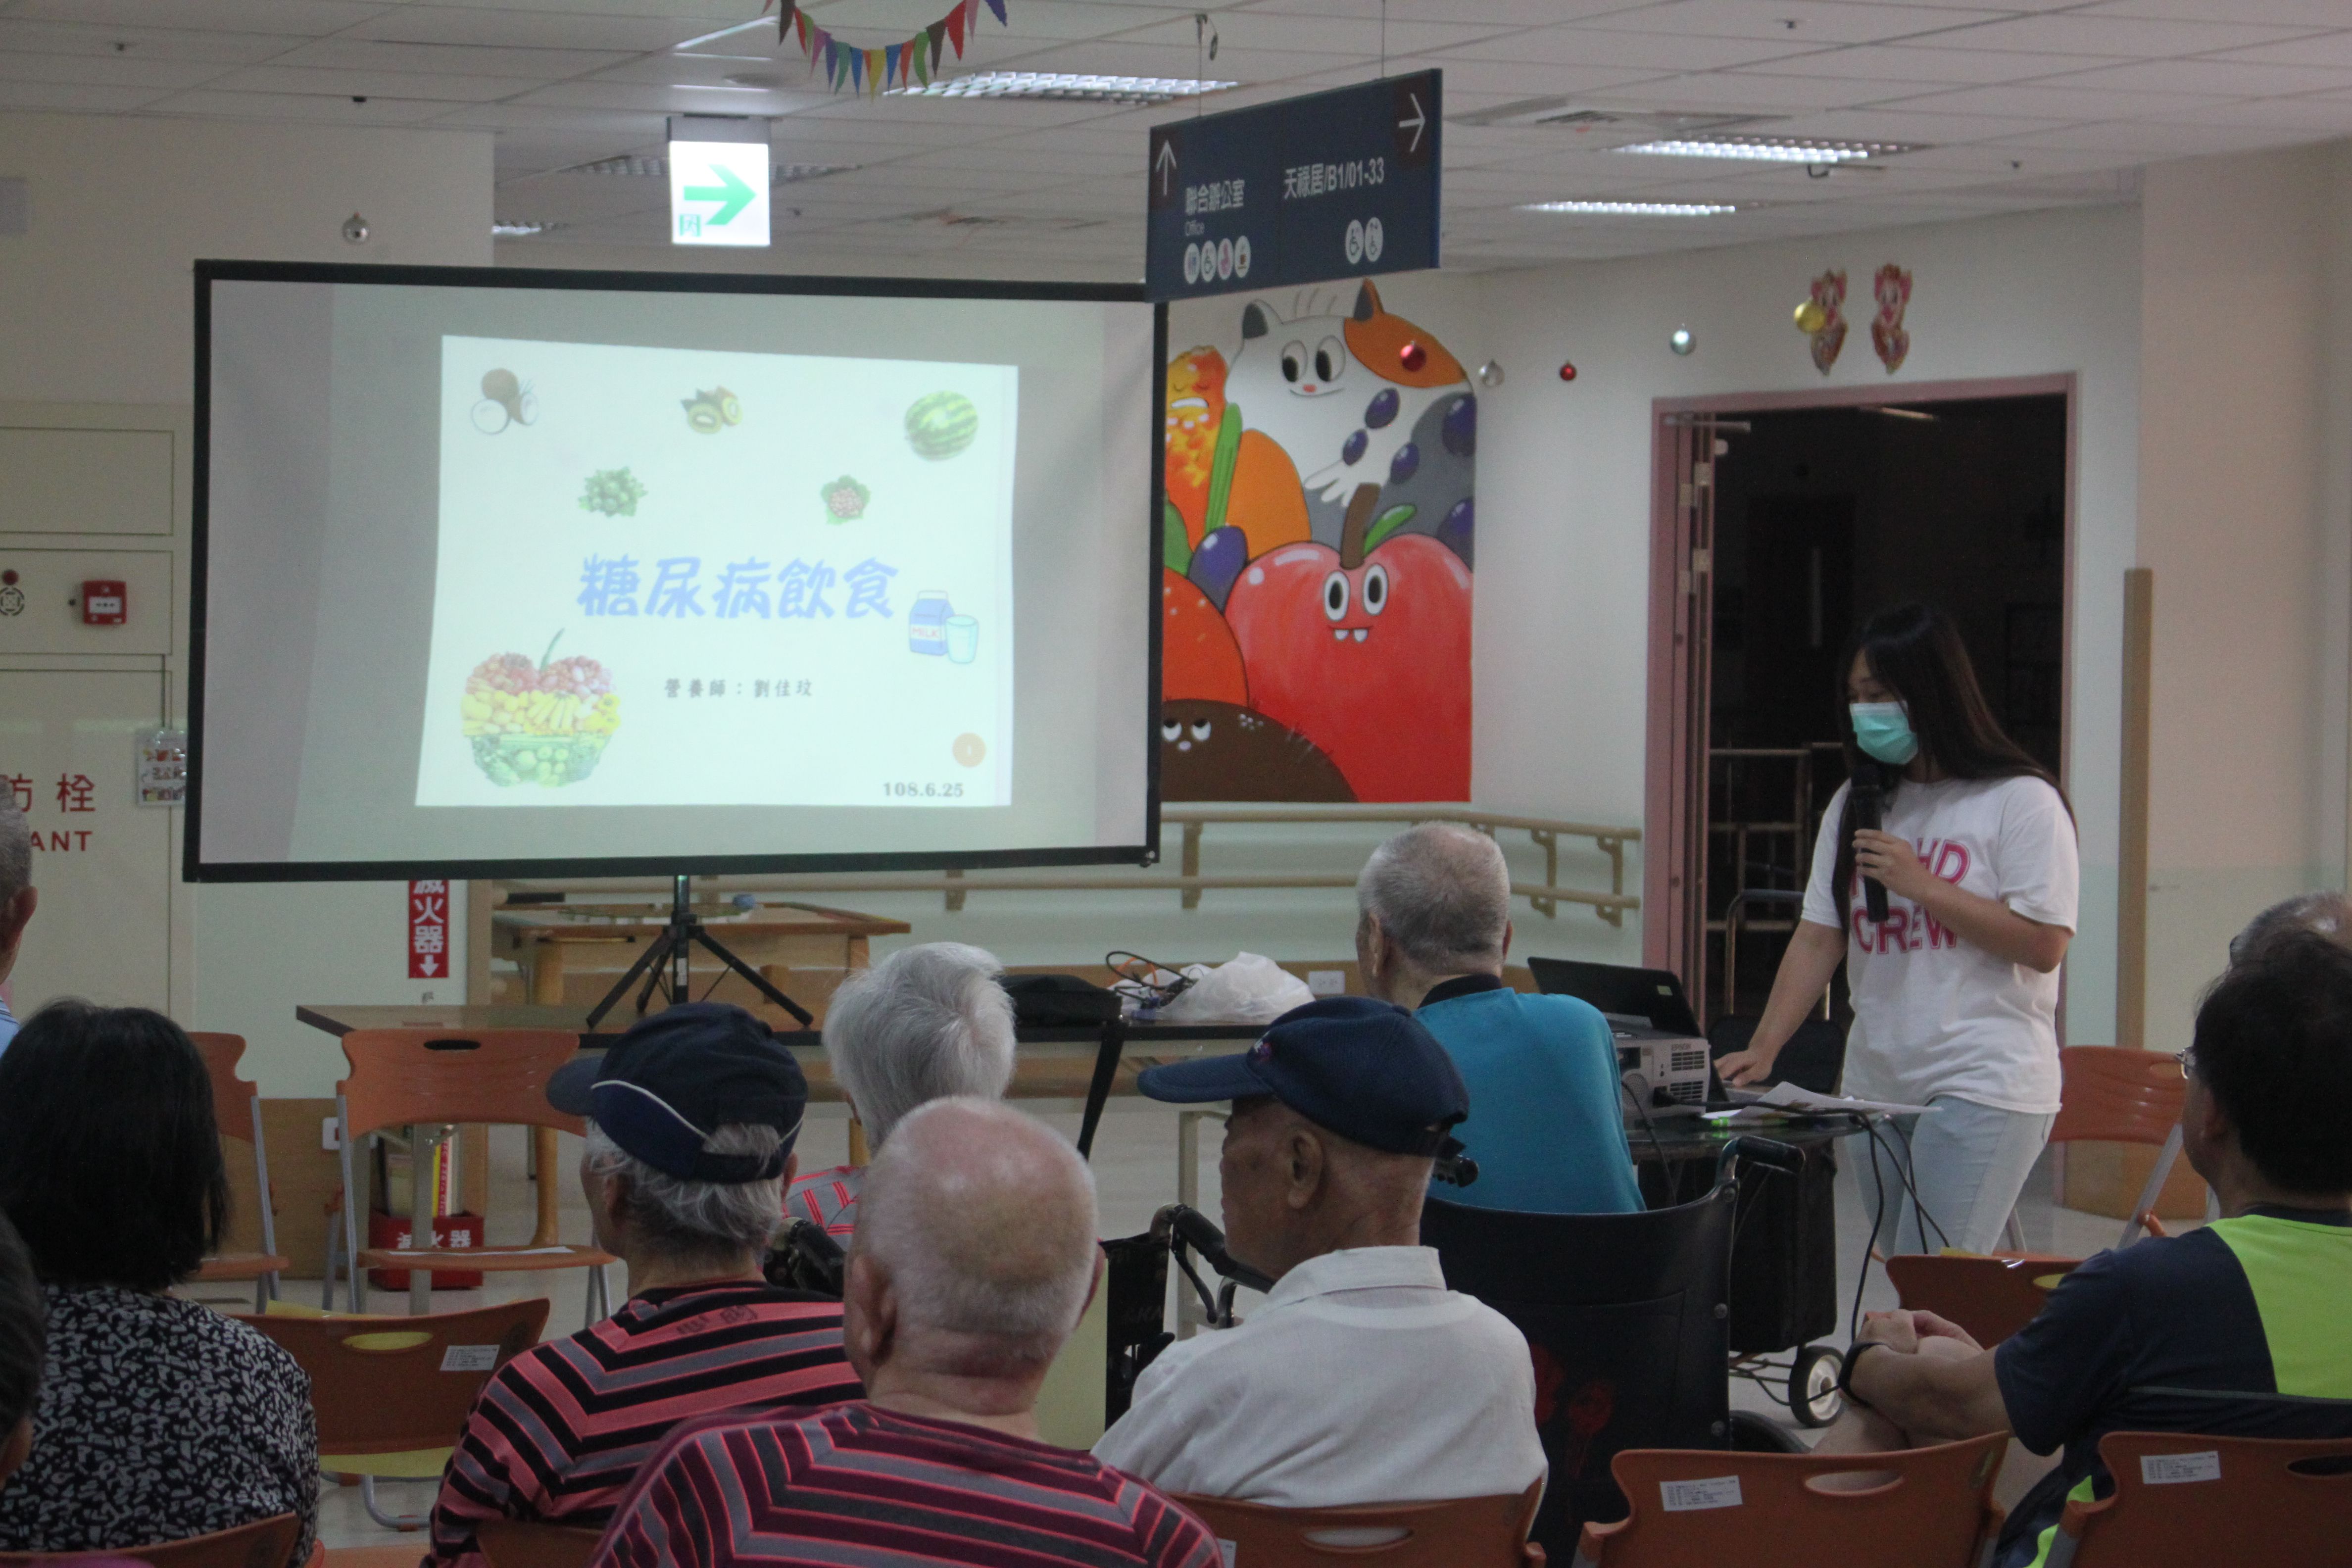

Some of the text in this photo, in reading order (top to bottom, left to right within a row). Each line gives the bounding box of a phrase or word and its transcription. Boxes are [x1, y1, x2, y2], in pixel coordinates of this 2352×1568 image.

[577, 552, 899, 620] 糖尿病飲食
[912, 627, 939, 638] MILK
[883, 782, 964, 798] 108.6.25
[31, 830, 93, 852] ANT
[1851, 906, 1958, 955] CREW
